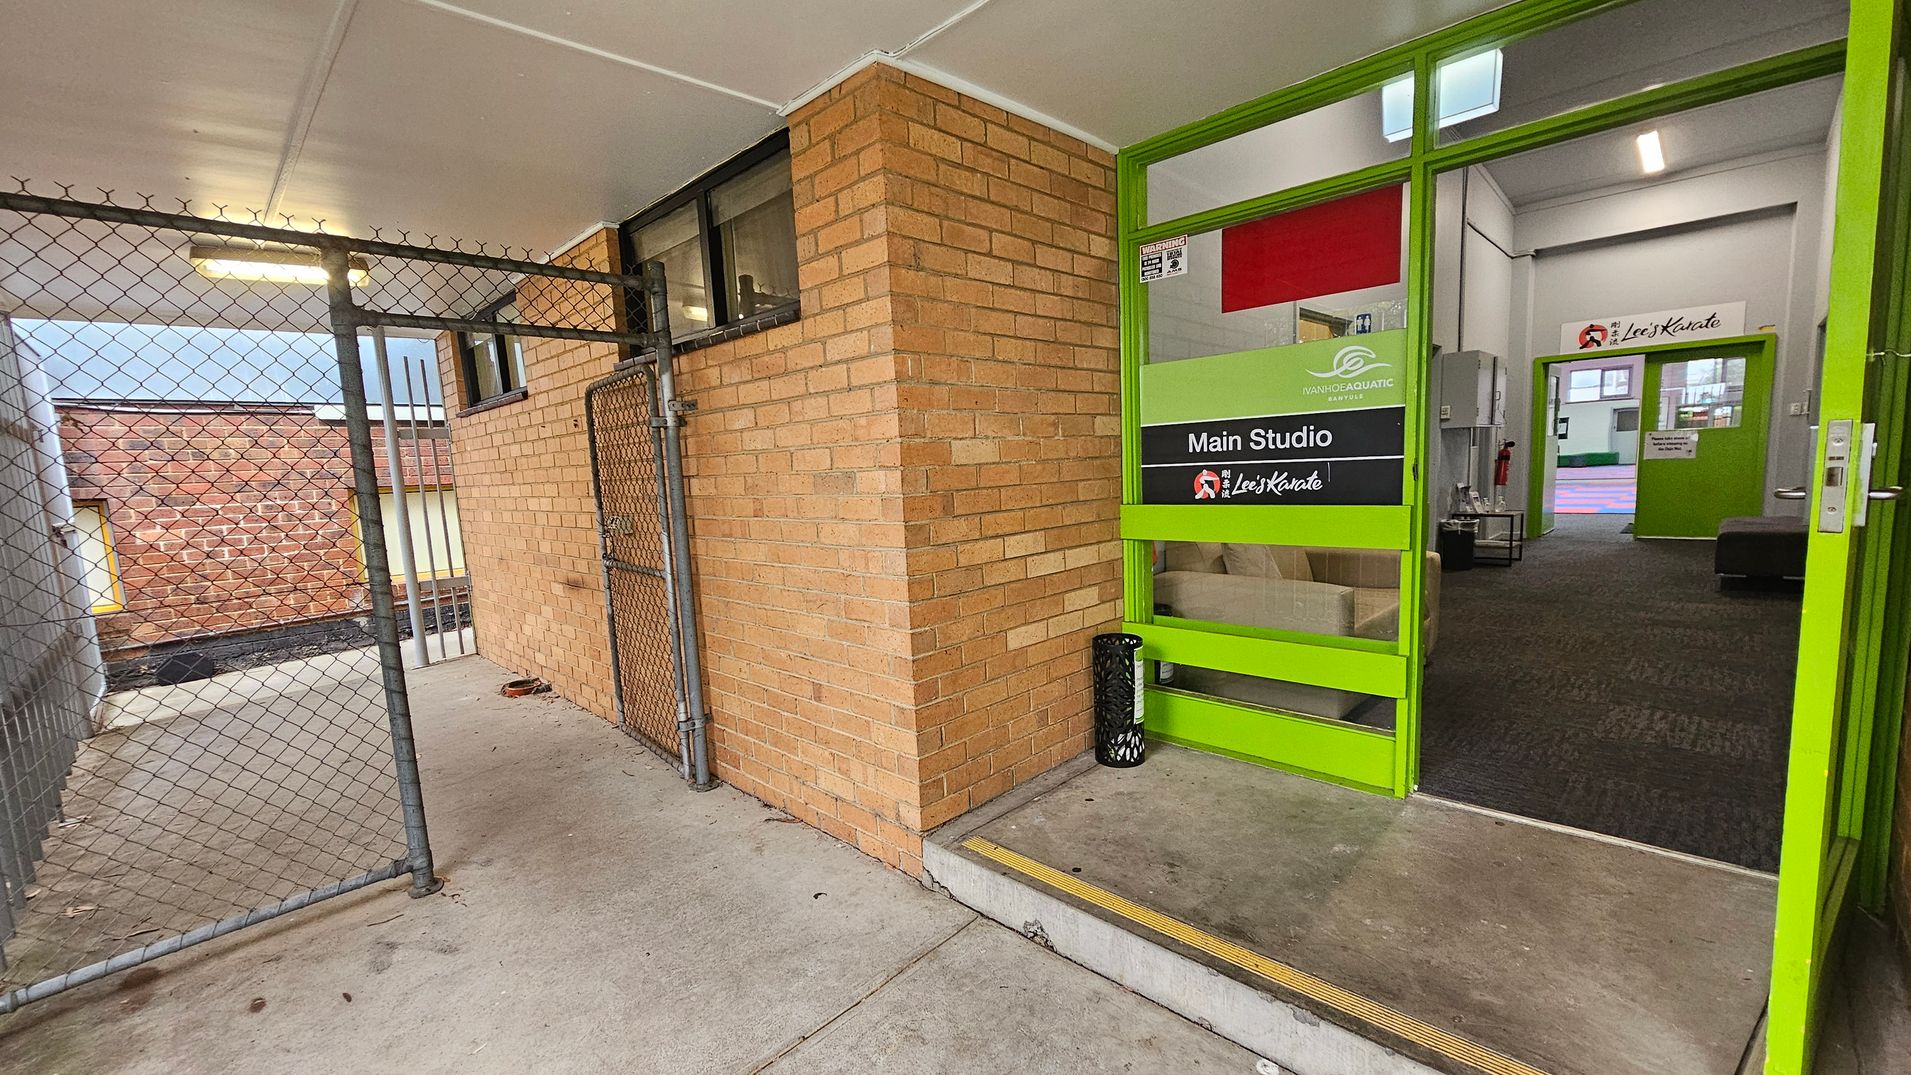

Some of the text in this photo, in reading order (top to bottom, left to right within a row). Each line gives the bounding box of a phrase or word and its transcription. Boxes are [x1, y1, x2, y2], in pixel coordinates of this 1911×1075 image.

[1142, 237, 1185, 254] WARNING
[1302, 378, 1394, 395] IVANHOEAQUATIC
[1328, 393, 1364, 402] BANYULE
[1188, 425, 1333, 453] Main Studio
